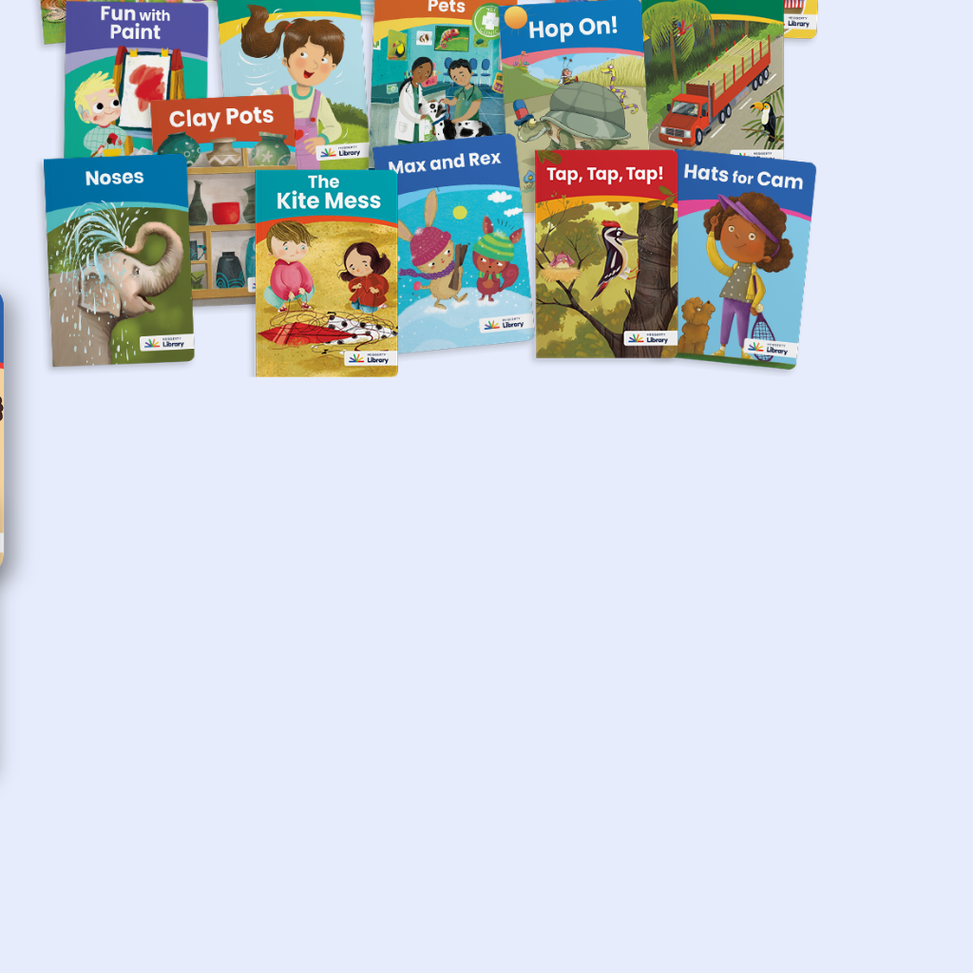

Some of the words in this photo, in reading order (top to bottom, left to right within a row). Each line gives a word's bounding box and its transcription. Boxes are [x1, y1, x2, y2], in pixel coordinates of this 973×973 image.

[100, 5, 136, 21] Fun
[139, 8, 171, 22] with
[110, 22, 161, 40] Paint
[529, 20, 574, 43] Hop
[579, 15, 618, 36] On!
[788, 20, 810, 28] Library
[169, 109, 221, 132] Clay
[226, 106, 274, 125] Pots
[388, 160, 427, 175] Max
[430, 153, 465, 171] and
[468, 152, 501, 167] Rex
[85, 170, 144, 186] Noses
[307, 174, 340, 189] The
[546, 167, 583, 185] Tap,
[586, 167, 623, 185] Tap,
[625, 166, 663, 185] Tap!
[684, 163, 729, 182] Hats
[732, 170, 754, 185] for
[757, 171, 803, 190] Cam
[277, 190, 320, 209] Kite
[325, 192, 381, 209] Mess
[502, 321, 524, 329] Library
[766, 346, 788, 356] Library
